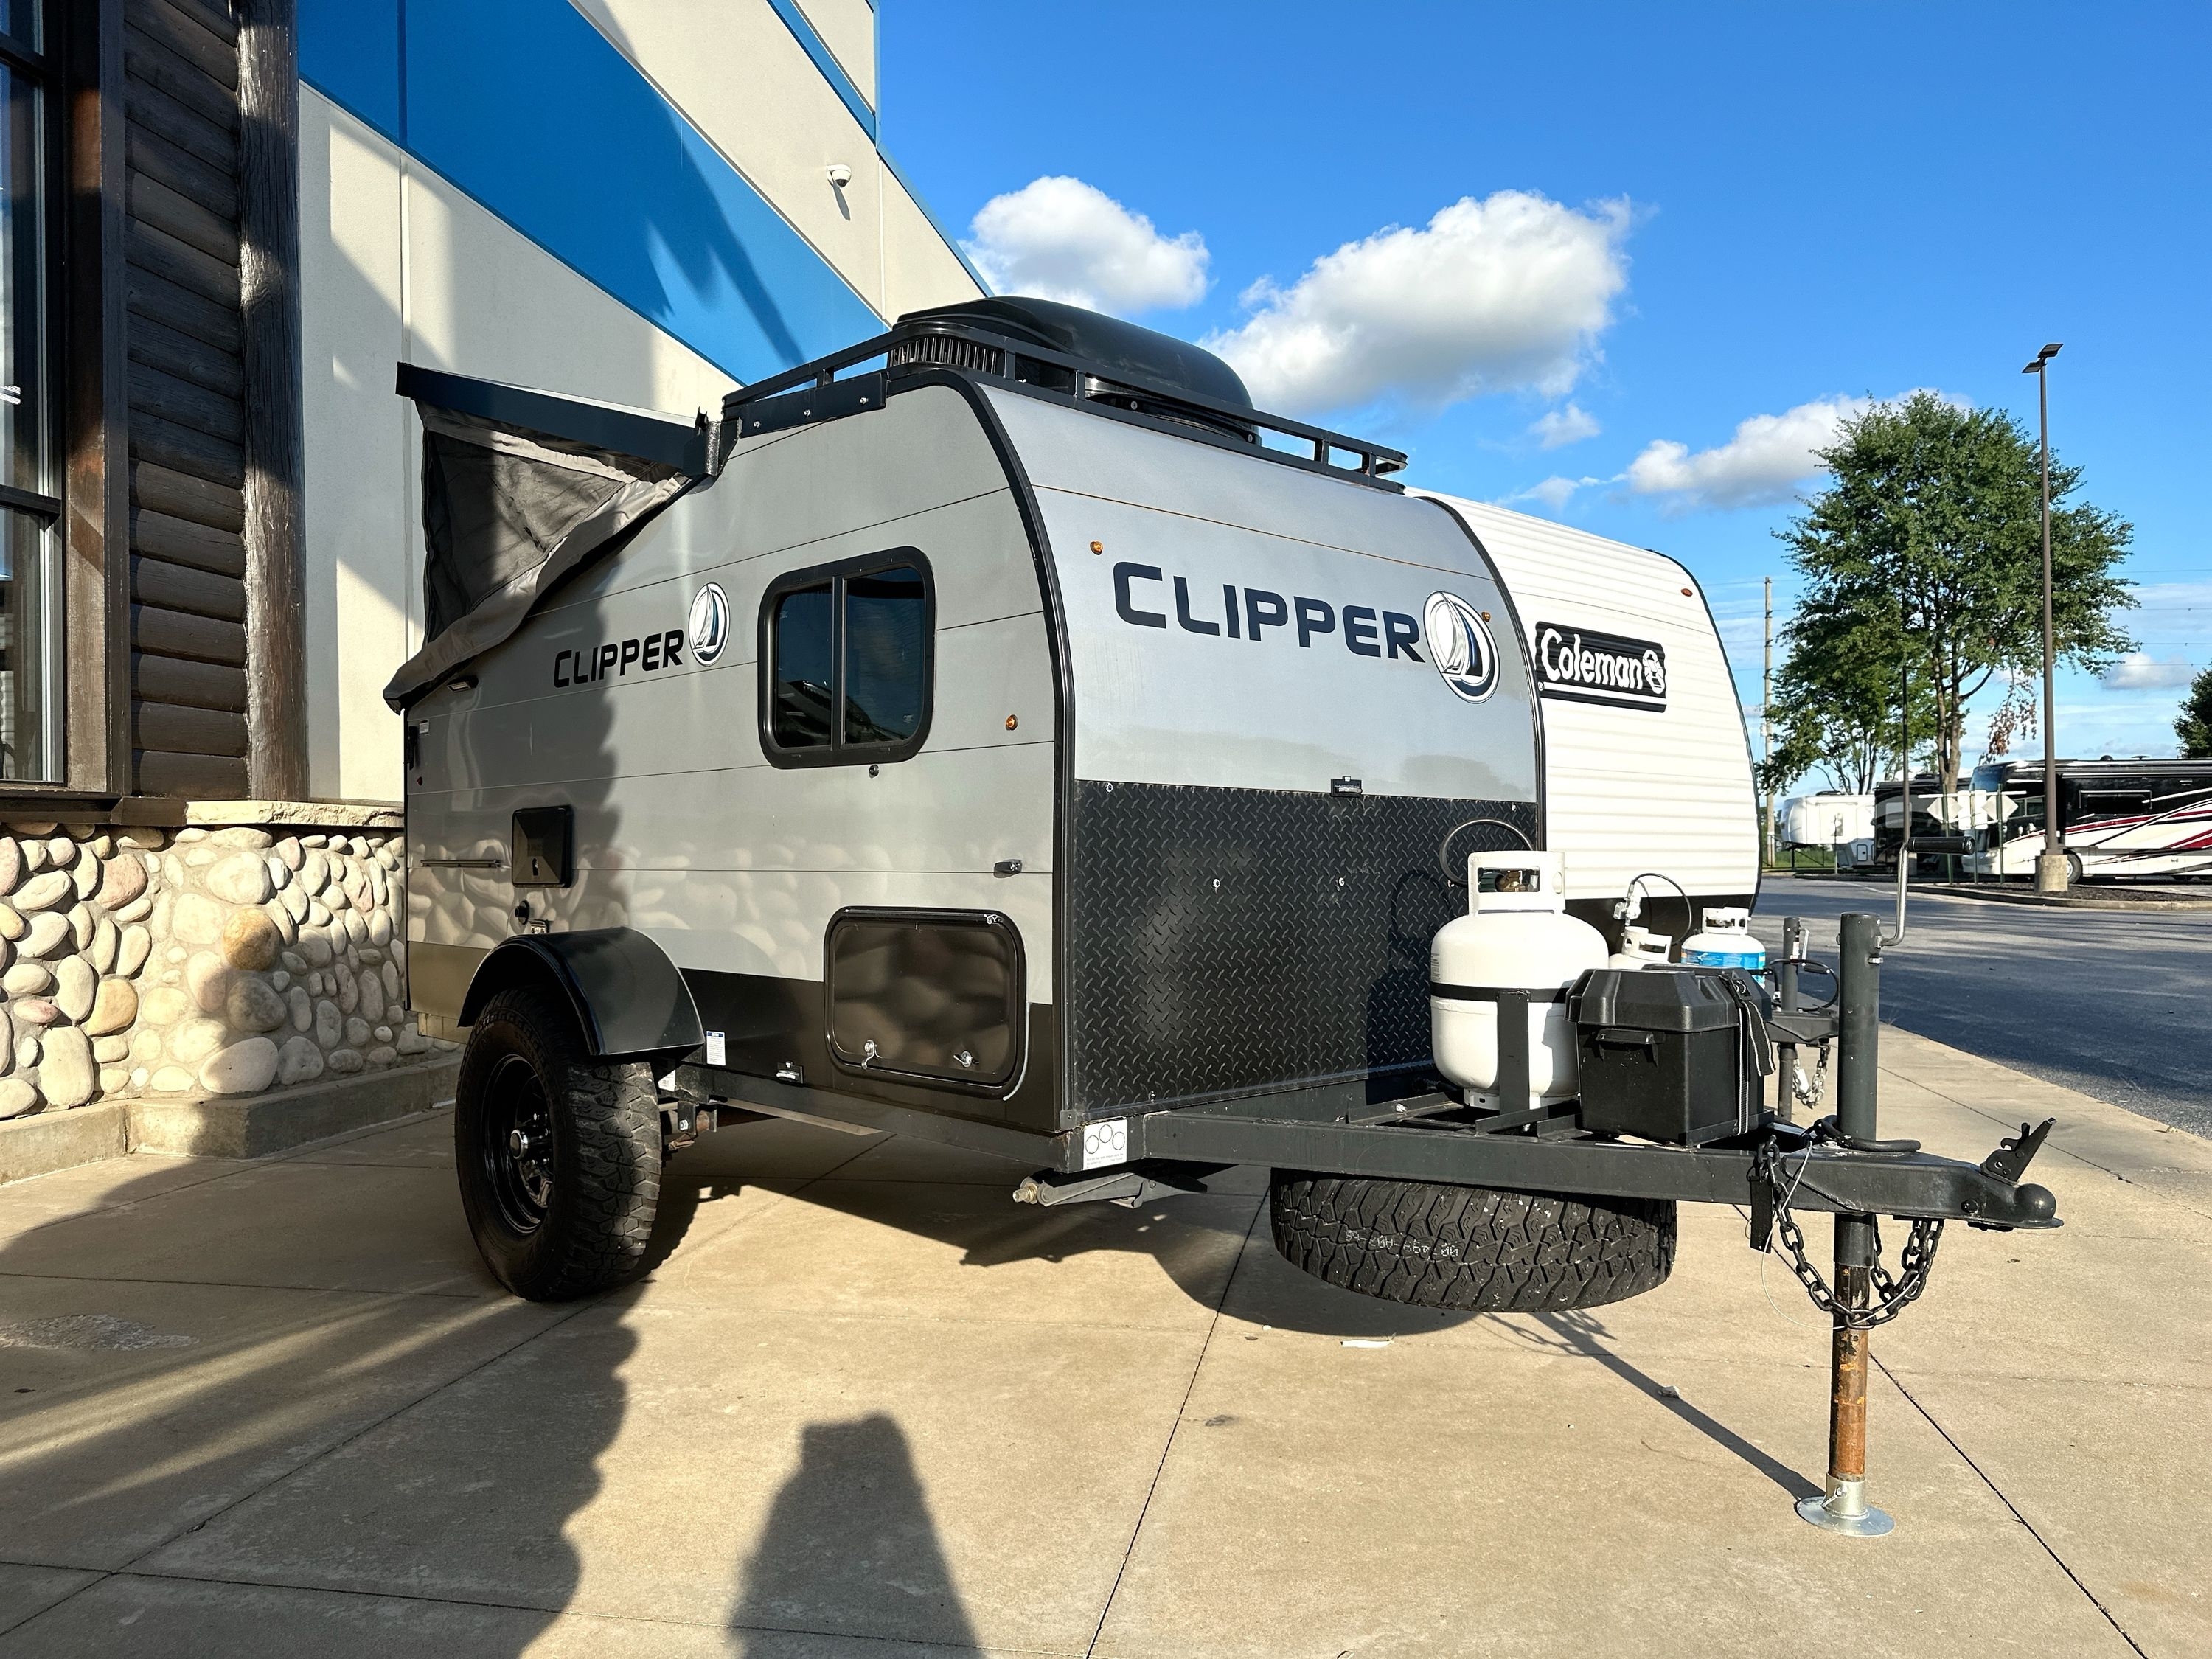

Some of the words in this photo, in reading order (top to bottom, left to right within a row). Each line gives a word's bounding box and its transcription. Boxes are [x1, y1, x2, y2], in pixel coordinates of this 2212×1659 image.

[1113, 562, 1425, 663] CLIPPER
[554, 629, 684, 688] CLIPPER
[1540, 627, 1643, 689] Coleman
